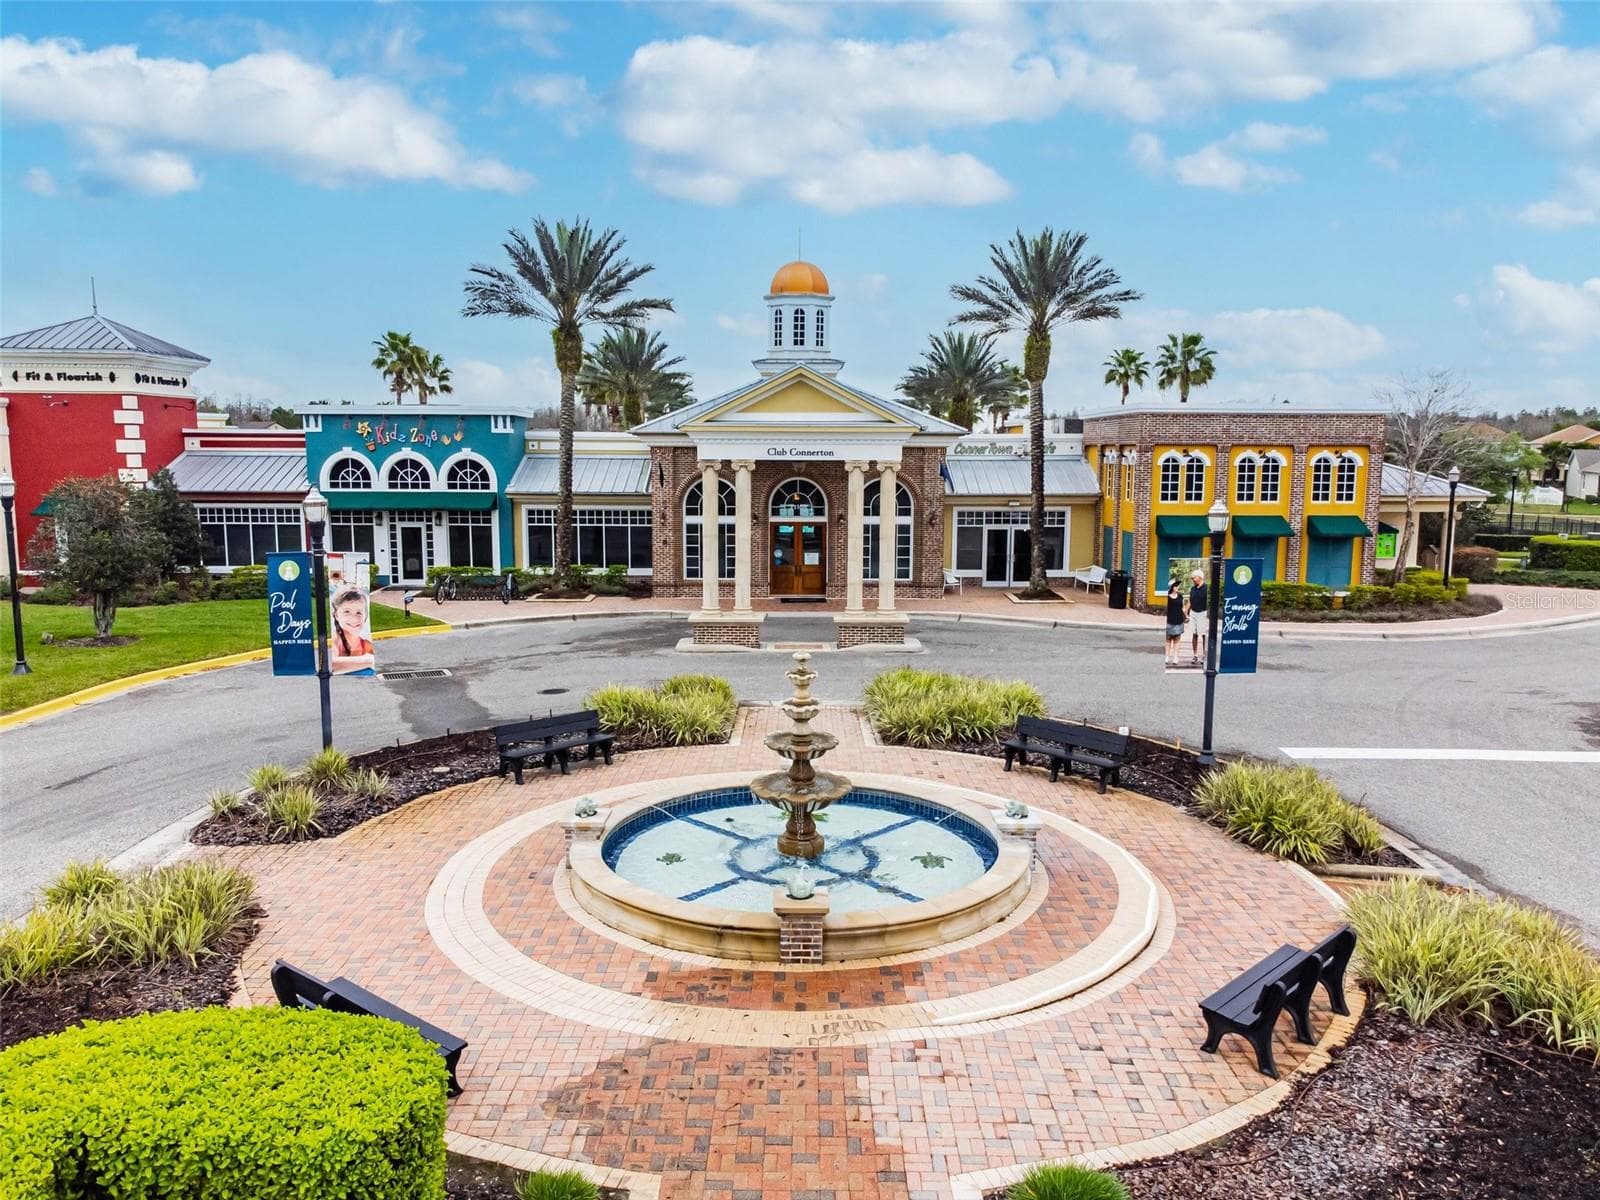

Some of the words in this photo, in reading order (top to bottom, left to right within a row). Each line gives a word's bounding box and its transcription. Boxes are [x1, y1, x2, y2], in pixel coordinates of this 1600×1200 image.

[25, 371, 41, 381] Fit
[44, 372, 54, 381] &
[56, 371, 103, 382] Flourish
[141, 374, 150, 383] Fit
[157, 376, 180, 386] Flourish
[375, 423, 406, 445] Kidz
[410, 427, 438, 448] Zone
[767, 447, 788, 456] Club
[789, 447, 834, 457] Connerton
[954, 442, 989, 455] Conner
[988, 442, 1013, 455] Town
[270, 589, 297, 613] Pool
[1224, 596, 1258, 620] Evening
[277, 611, 312, 639] Days
[1222, 615, 1248, 634] Strolls
